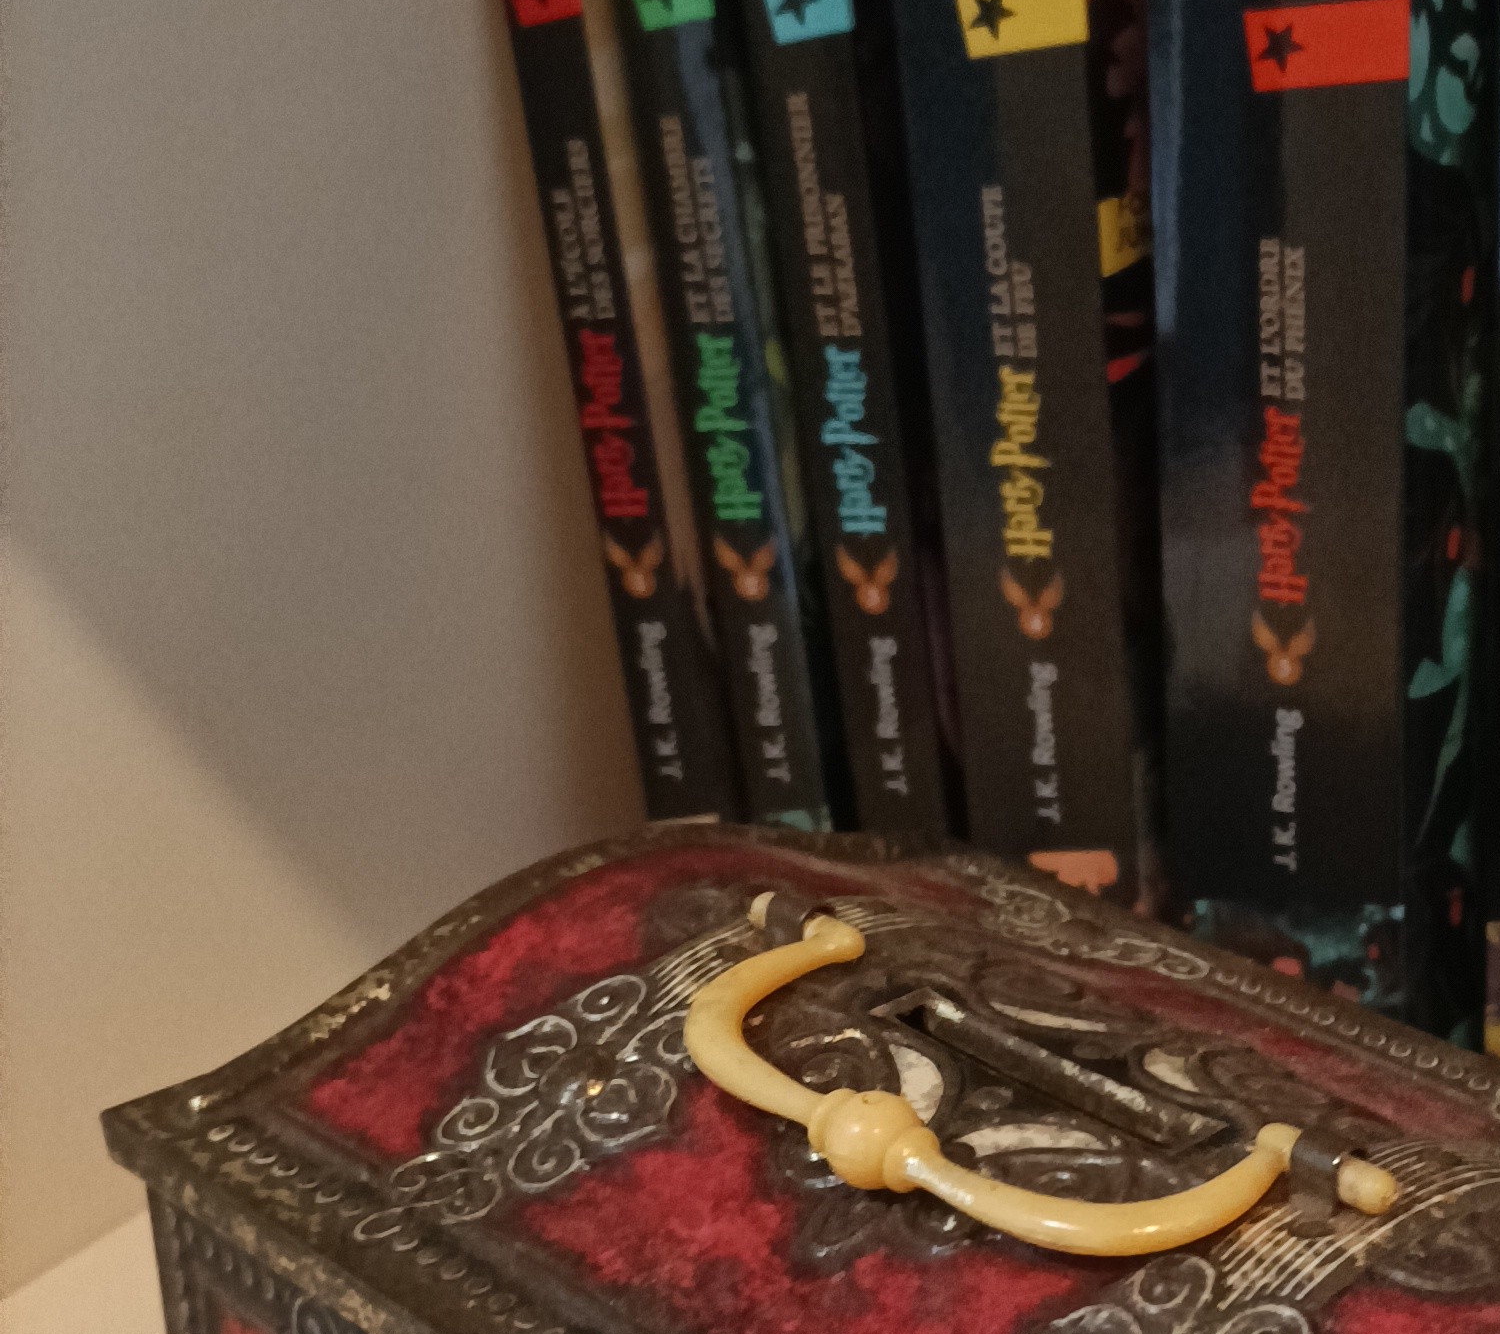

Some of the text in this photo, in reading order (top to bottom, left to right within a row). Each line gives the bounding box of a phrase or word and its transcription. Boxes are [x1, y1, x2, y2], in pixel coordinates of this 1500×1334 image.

[567, 138, 616, 319] DES SORCIERS
[659, 114, 712, 323] ET LA CHAMBRE
[692, 157, 735, 322] DES SECRETS
[786, 91, 840, 338] ET LE PRISONNIER
[822, 192, 863, 338] D'AZKABAN
[980, 184, 1014, 358] ET LA COUPE
[1010, 260, 1039, 359] DE FEU
[1258, 237, 1282, 397] ET L'ORDRE
[1284, 358, 1307, 401] DU
[578, 328, 649, 518] Harry Potter
[693, 331, 763, 521] Harry Potter
[819, 341, 888, 537] Harry Potter
[988, 364, 1054, 562] Harry Potter
[1250, 405, 1311, 607] Harry Potter
[637, 620, 684, 783] J. K. Rowling
[747, 622, 792, 785] J. K. Rowling
[867, 636, 911, 796] J. K. Rowling
[1026, 661, 1063, 825] J. K. Rowling
[1269, 707, 1305, 874] J. K. Rowling
